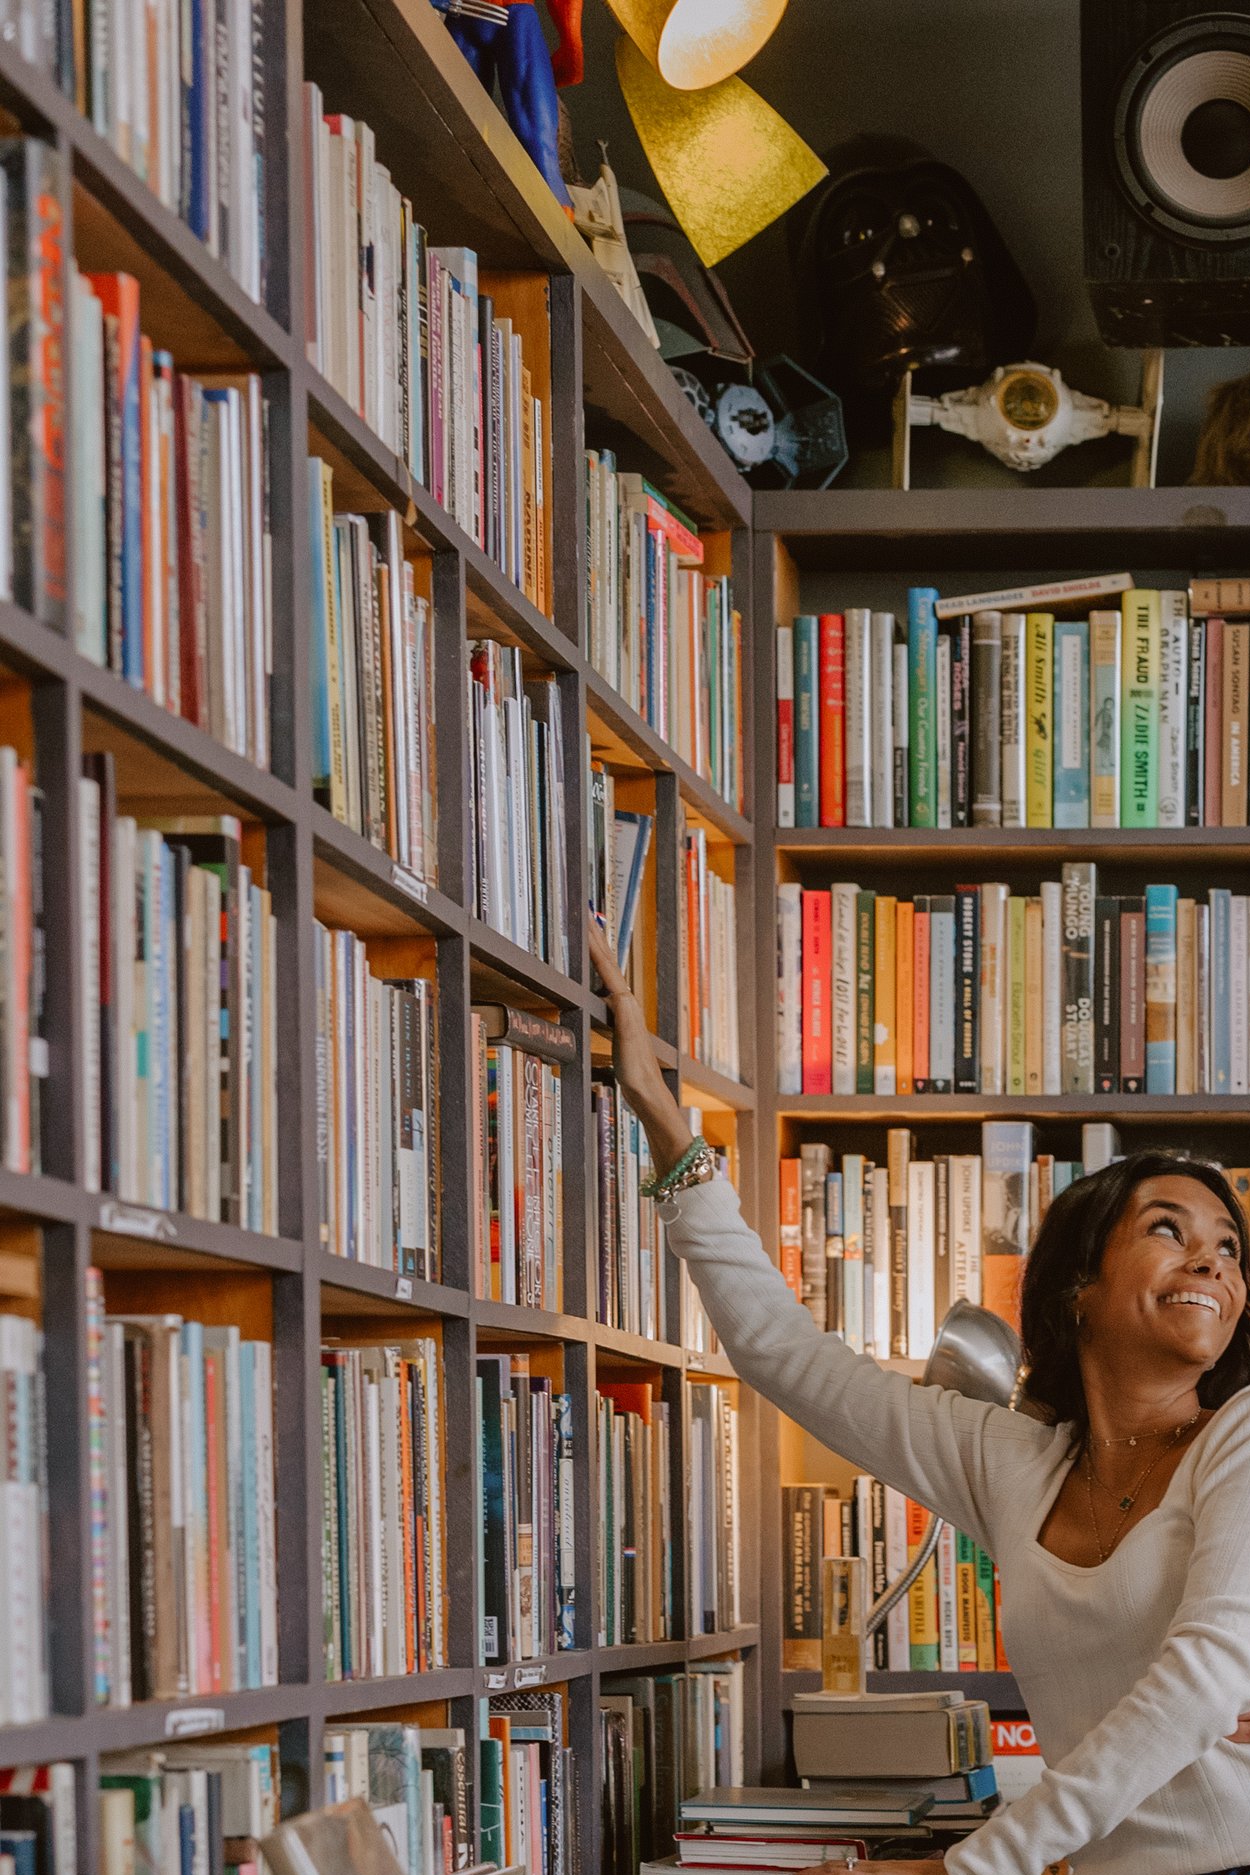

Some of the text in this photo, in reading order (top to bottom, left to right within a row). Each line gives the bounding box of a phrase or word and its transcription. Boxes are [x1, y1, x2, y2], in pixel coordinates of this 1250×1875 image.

[523, 491, 532, 589] NADINE
[1032, 585, 1060, 597] DAVID
[1136, 604, 1149, 684] THE FRAUD
[1231, 629, 1240, 666] SUSAN
[1034, 655, 1046, 704] Smith
[916, 720, 929, 796] Country Friends
[1134, 704, 1149, 798] ZADIE SMITH
[1230, 721, 1240, 786] IN AMERICA
[1065, 879, 1078, 940] MUNGO
[1079, 882, 1091, 937] YOUNG
[1012, 982, 1022, 1027] Elizabeth
[1066, 1004, 1077, 1060] STUART
[1078, 997, 1090, 1067] DOUGLAS
[404, 1003, 412, 1098] JOHN IRVING
[315, 1036, 328, 1162] HERMANN HESSE
[961, 1598, 970, 1642] MANIFESTO
[457, 1752, 468, 1834] essential
